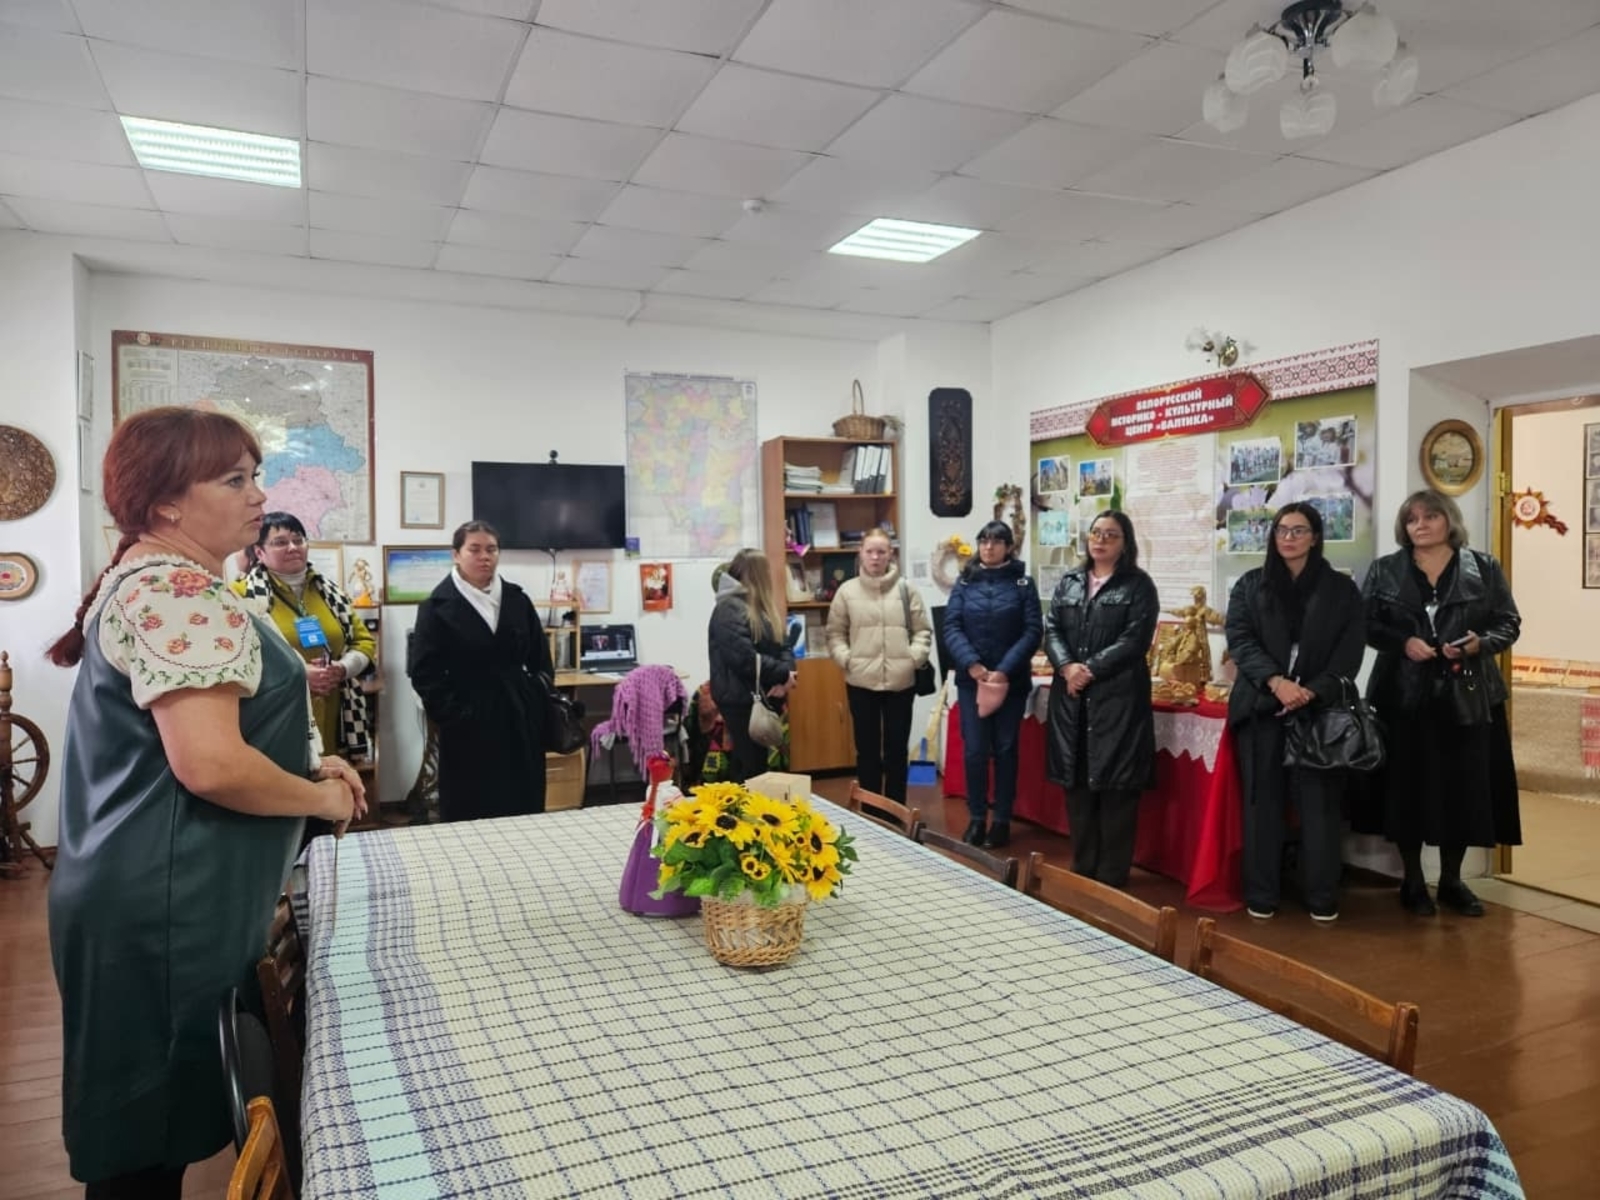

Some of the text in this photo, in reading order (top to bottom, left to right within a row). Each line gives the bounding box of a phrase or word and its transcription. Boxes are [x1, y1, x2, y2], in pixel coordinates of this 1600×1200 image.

[1136, 388, 1202, 410] БЕЛОРУССКИЙ
[1111, 411, 1155, 427] ИСТОРИКО
[1165, 394, 1233, 418] КУЛЬТУРНЫЙ
[1125, 414, 1214, 436] ЦЕНТР «БАЛТИКА»
